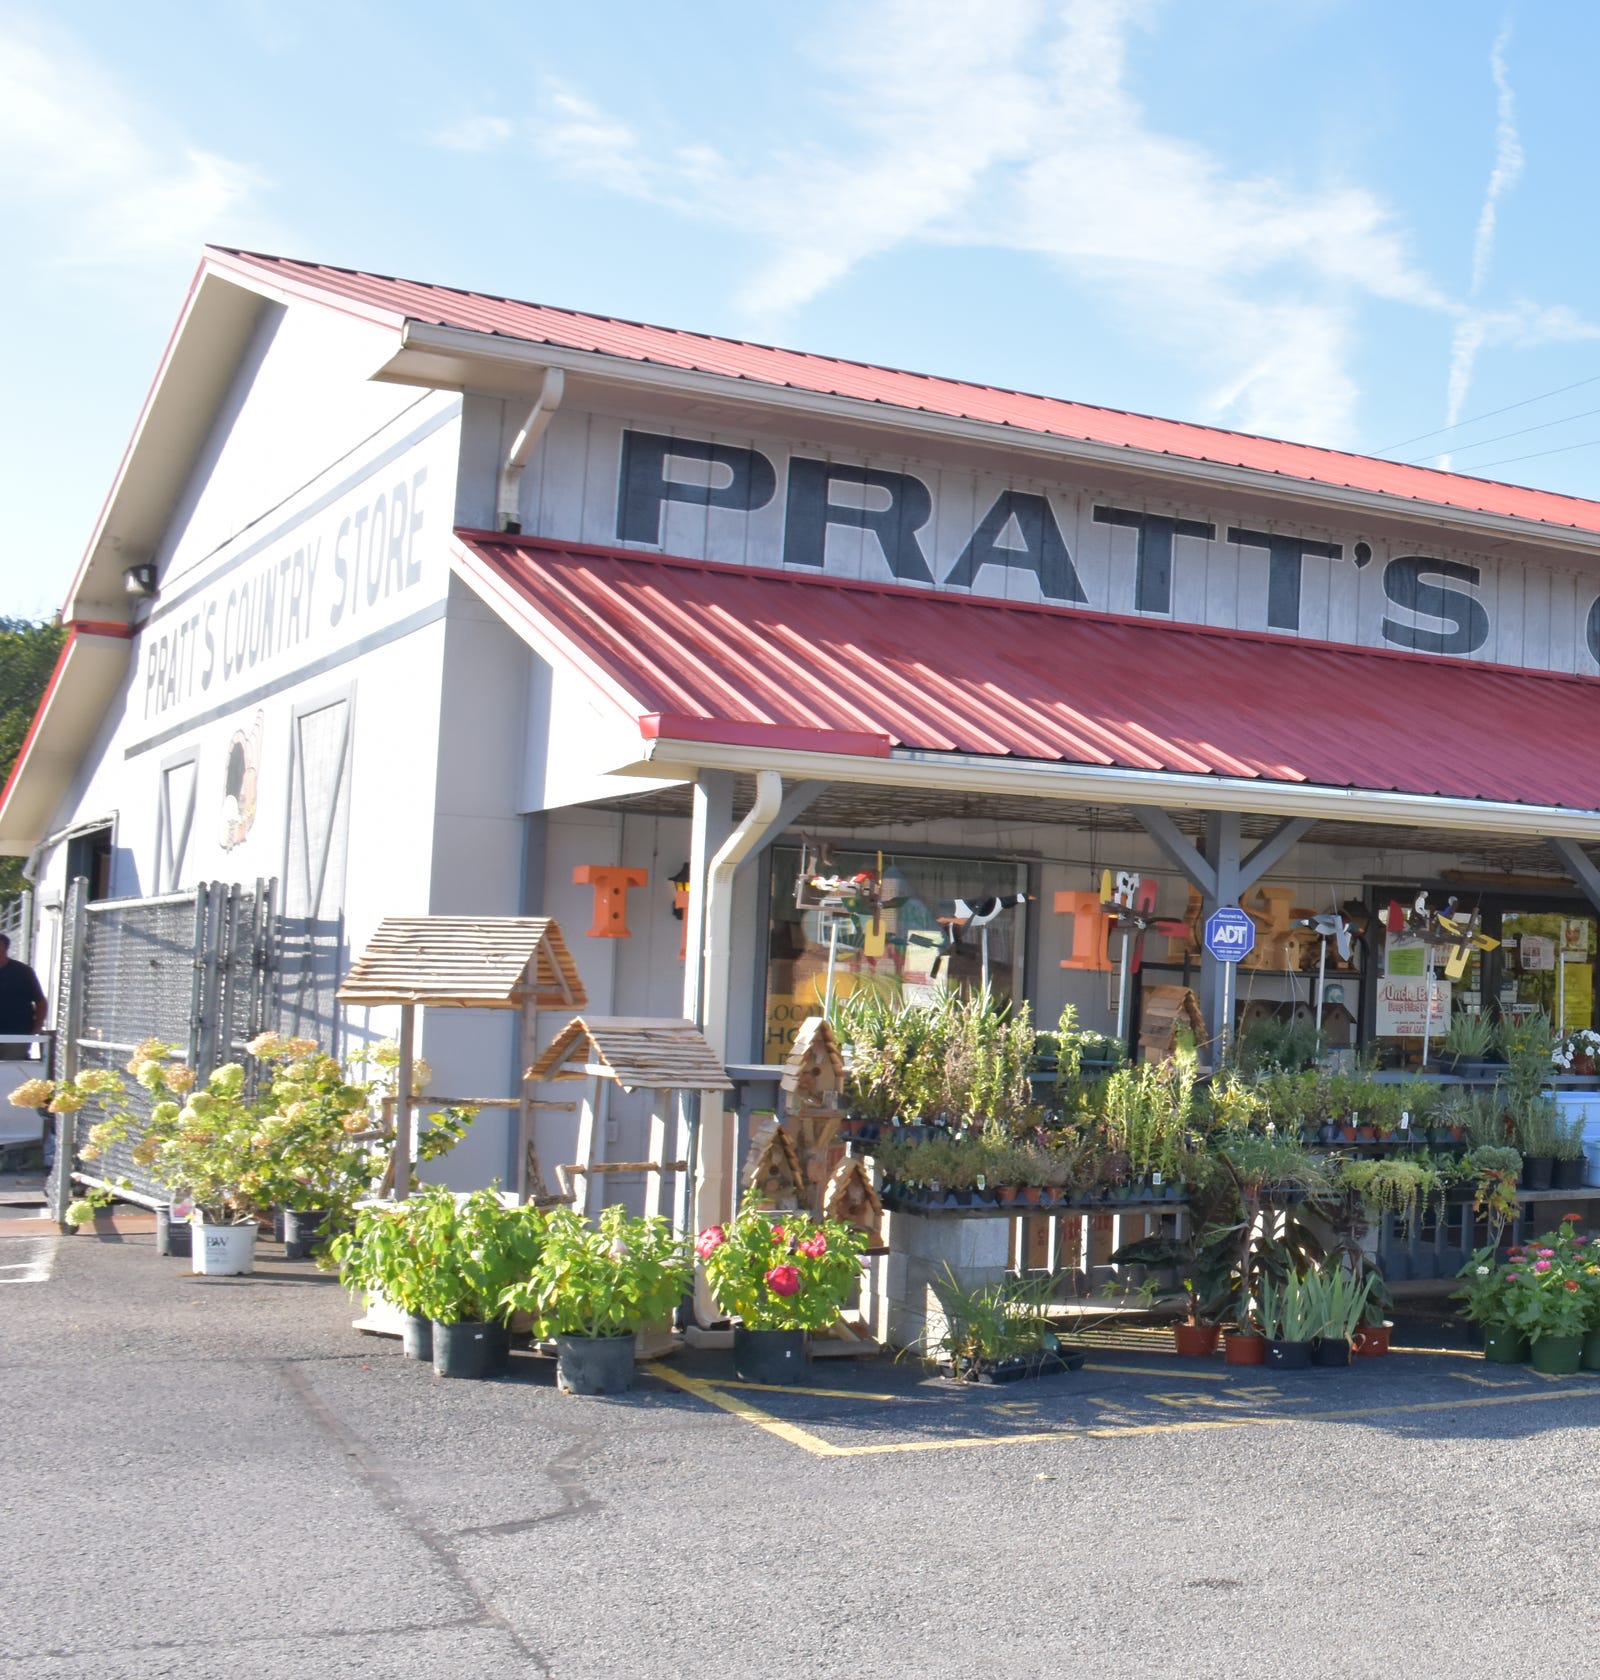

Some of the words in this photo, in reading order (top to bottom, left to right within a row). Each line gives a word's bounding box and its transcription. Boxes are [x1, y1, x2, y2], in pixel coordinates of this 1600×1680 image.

[144, 599, 217, 721] PRATT'S
[223, 535, 322, 682] COUNTRY
[330, 465, 428, 628] STORE
[616, 429, 1490, 655] PRATT'S
[1213, 925, 1247, 944] ADT
